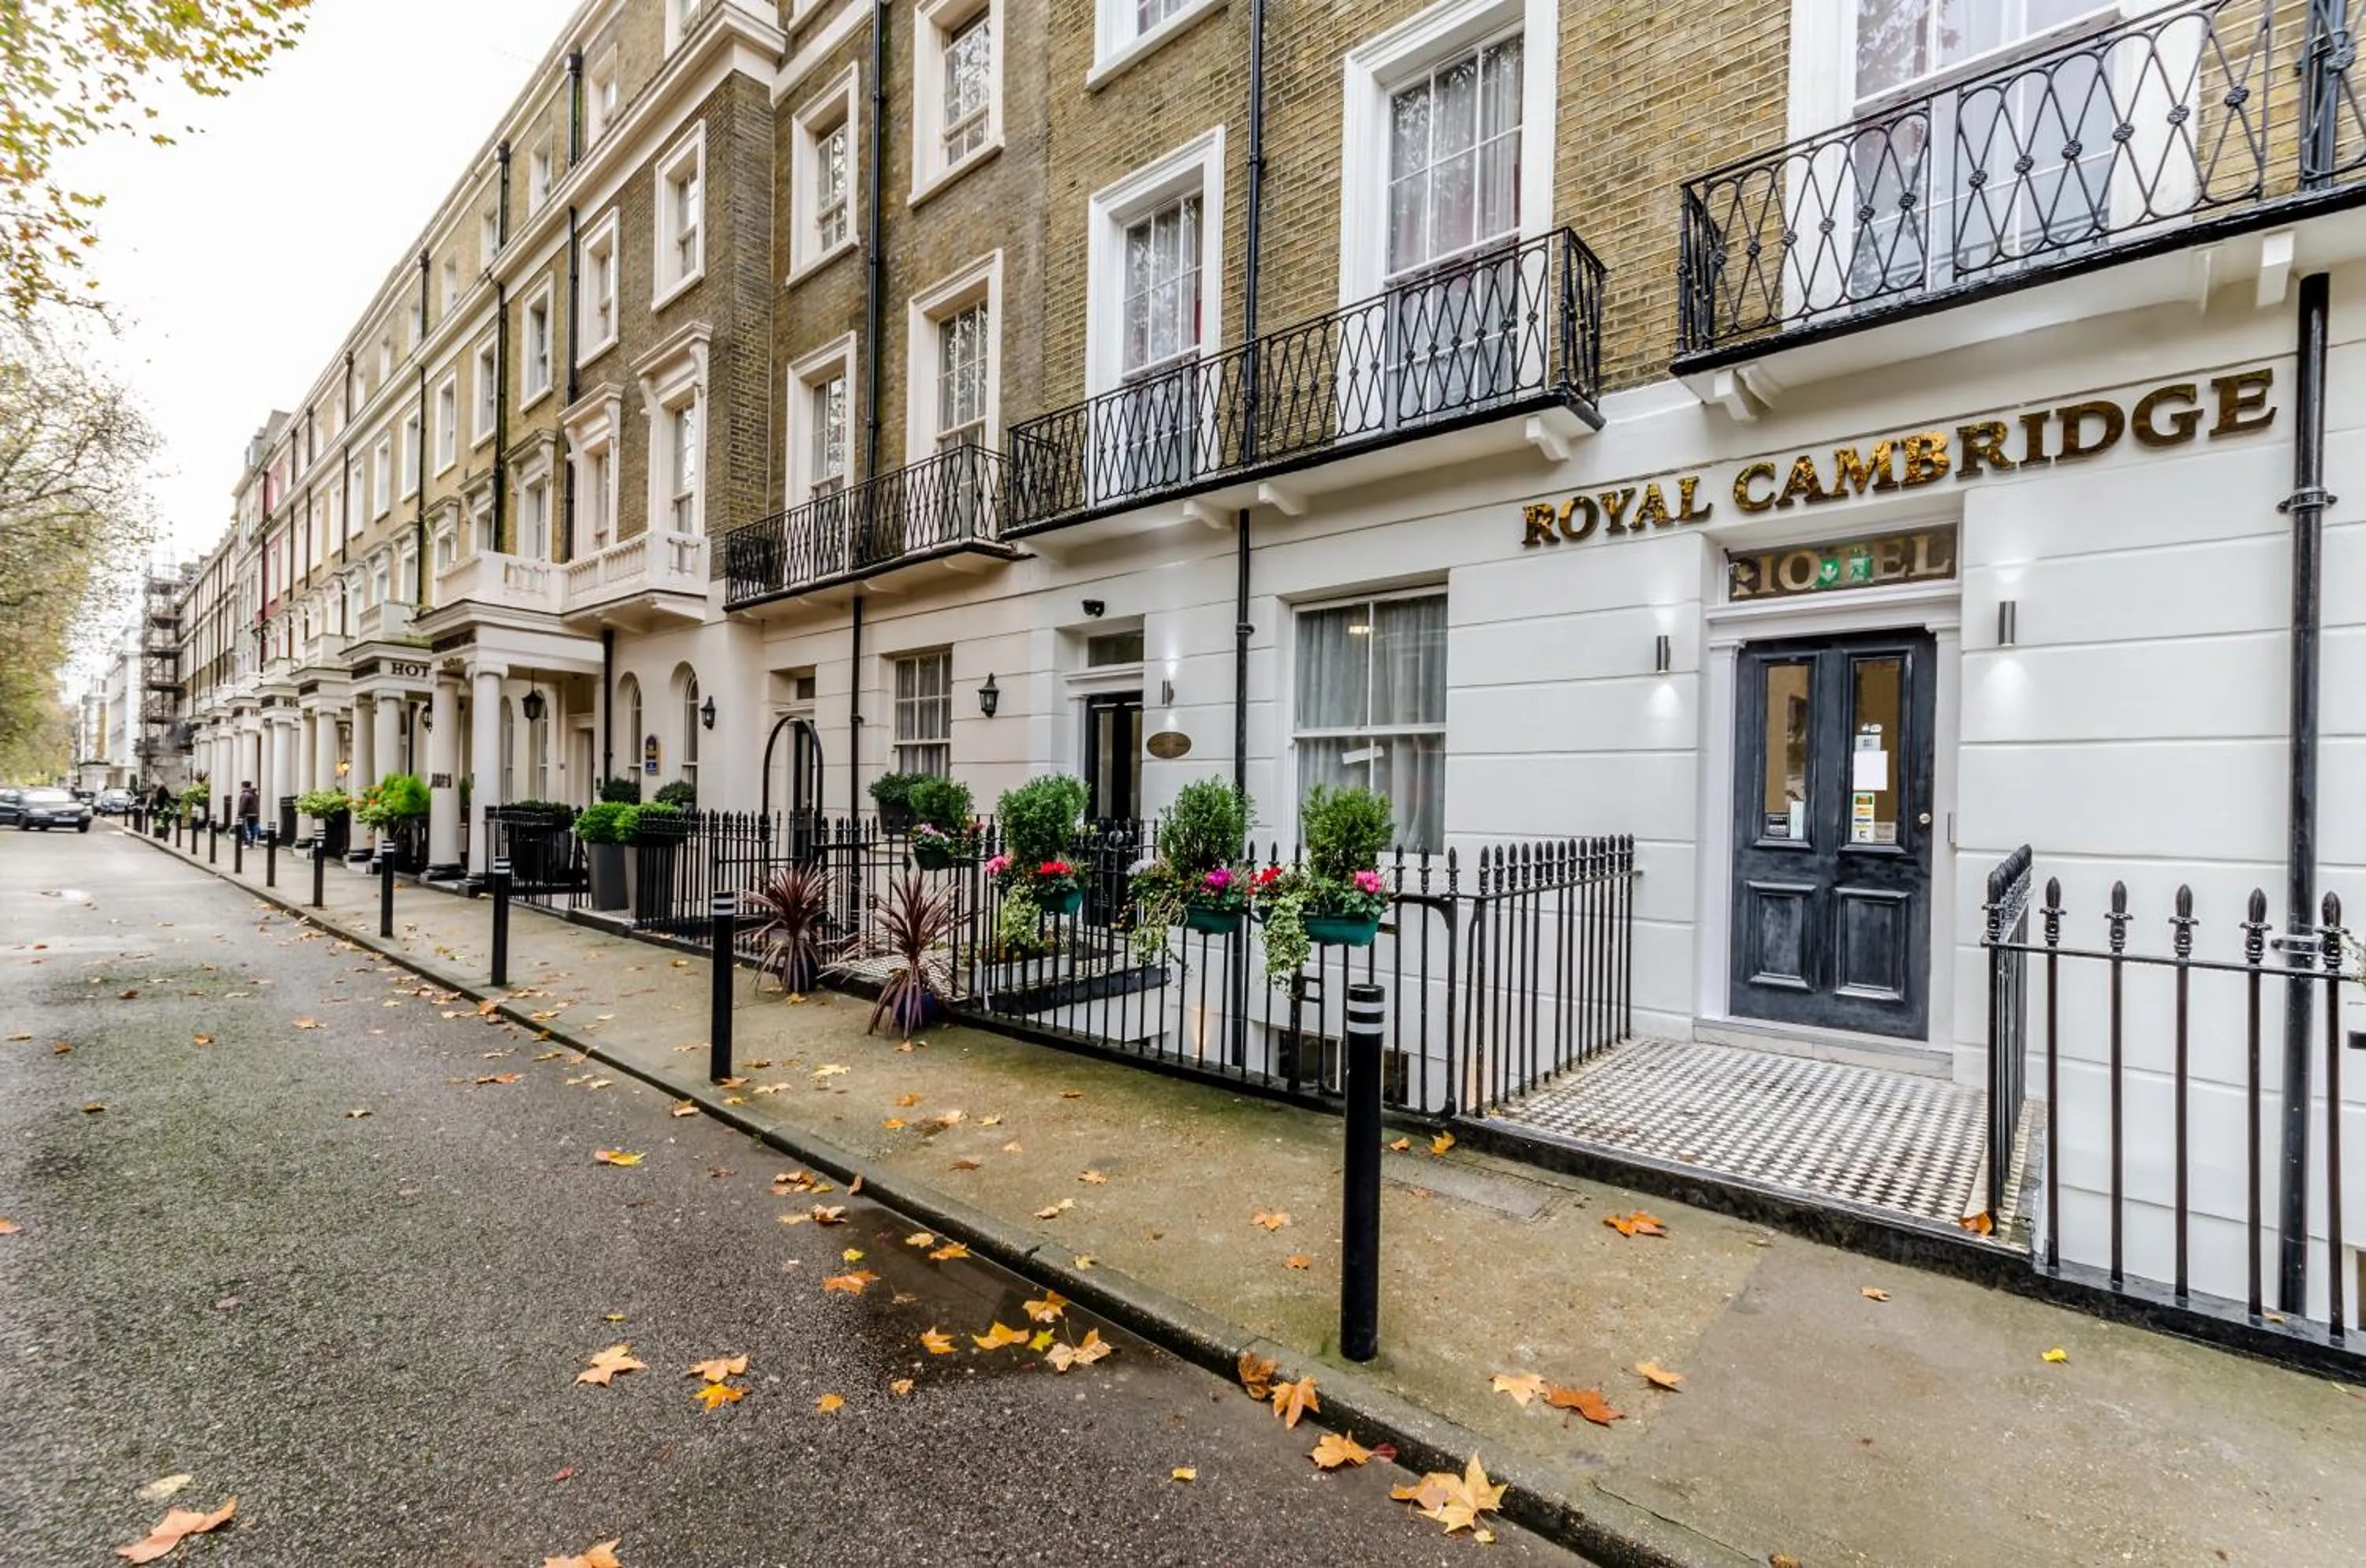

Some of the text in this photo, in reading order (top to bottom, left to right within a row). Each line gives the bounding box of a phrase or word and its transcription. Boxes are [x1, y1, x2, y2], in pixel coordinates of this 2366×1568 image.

[1521, 368, 2278, 546] ROYAL CAMBRIDGE
[1730, 534, 1951, 596] HOTEL
